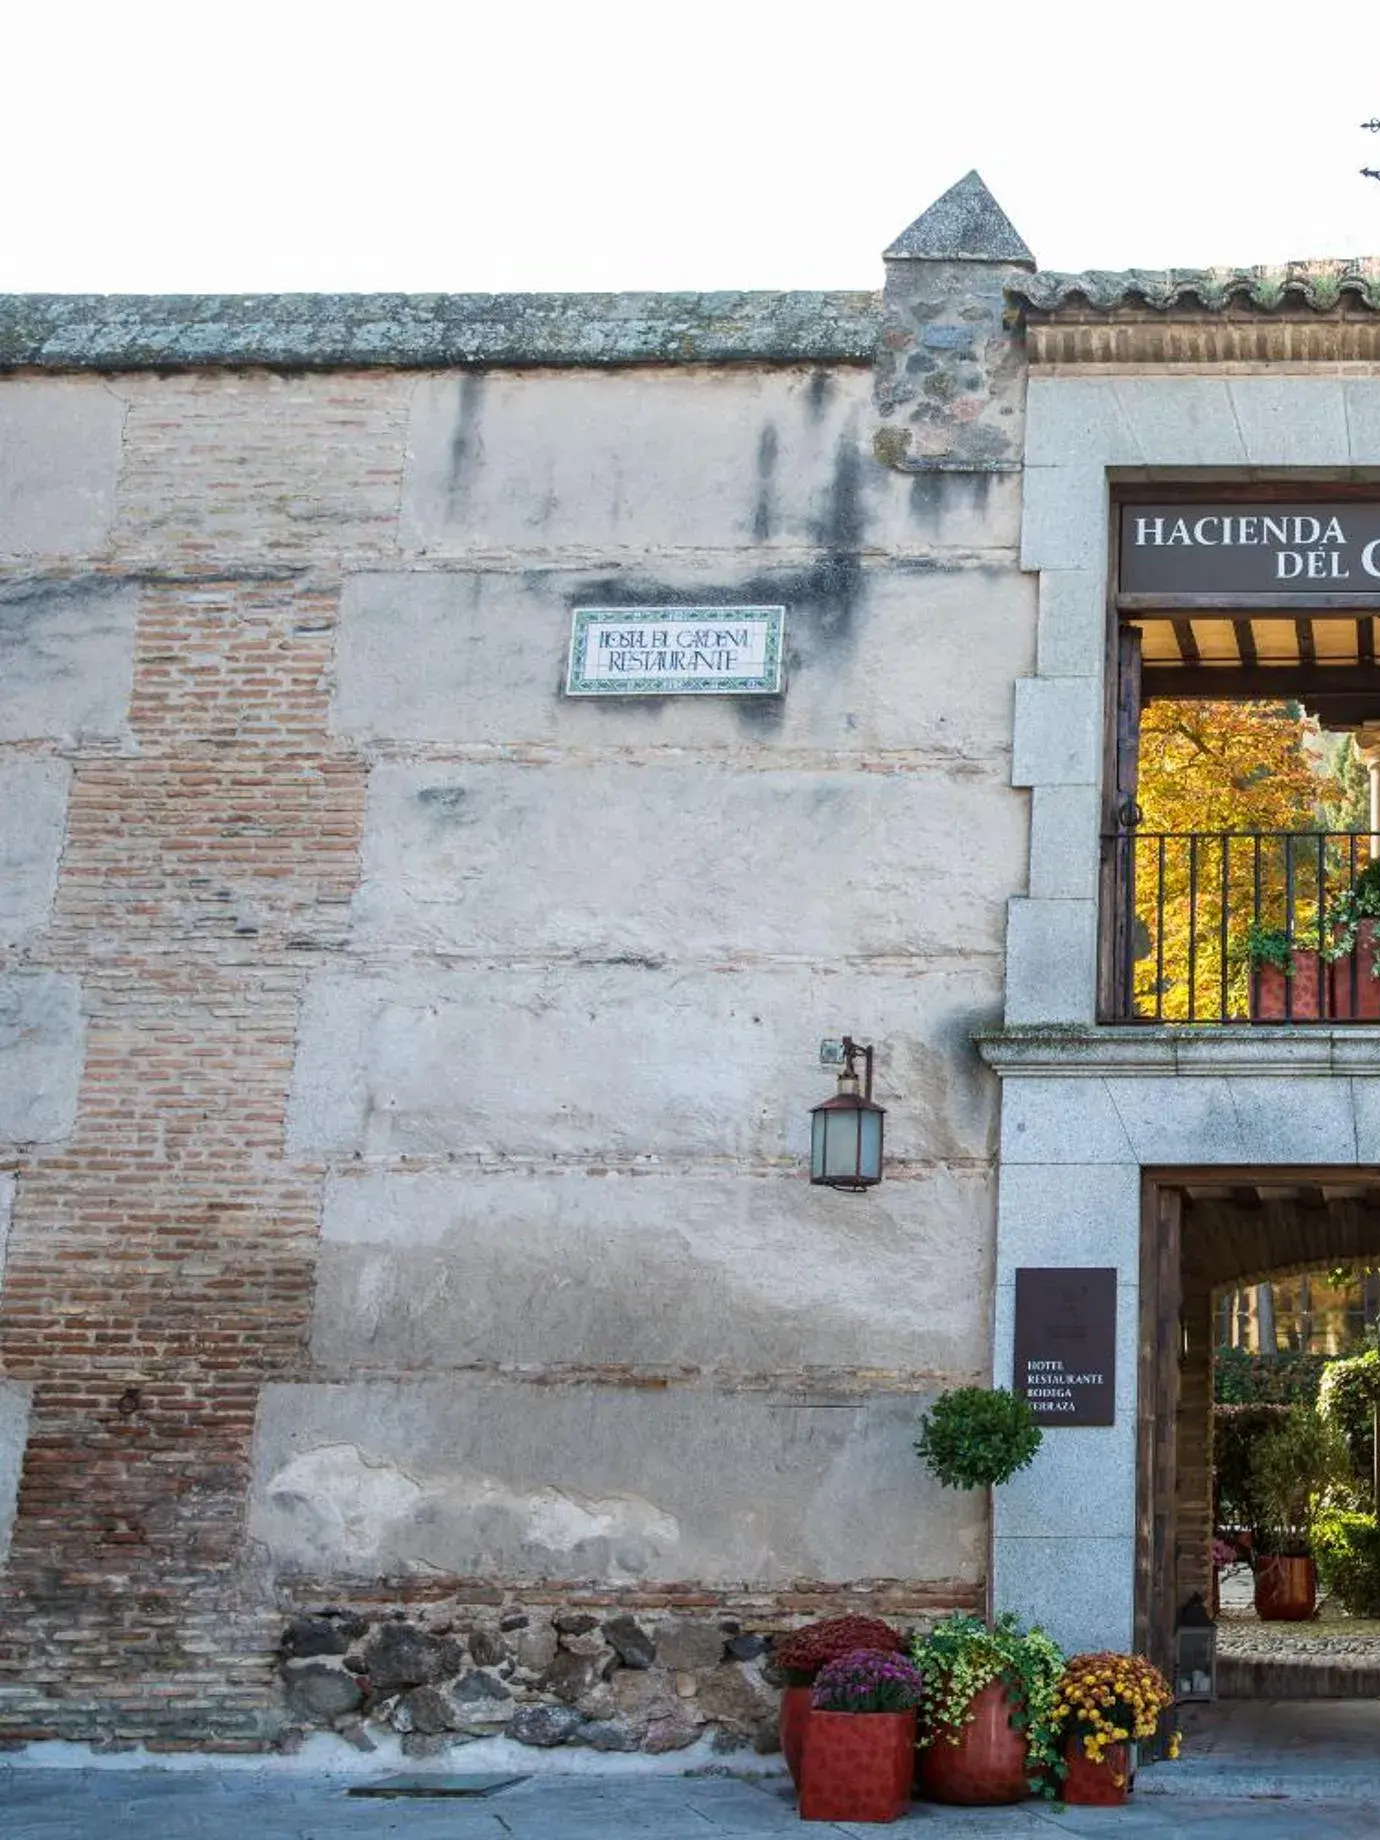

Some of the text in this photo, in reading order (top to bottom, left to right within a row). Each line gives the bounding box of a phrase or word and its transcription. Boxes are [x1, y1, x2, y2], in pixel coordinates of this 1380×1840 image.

[1135, 515, 1348, 546] HACIENDA
[599, 630, 649, 649] HOSTAL
[651, 629, 669, 649] EL
[608, 650, 739, 672] RESTAURANTE
[1027, 1360, 1064, 1371] HOTEL
[1027, 1374, 1104, 1385] RESTAURANTE
[1027, 1388, 1072, 1398] BODEGA
